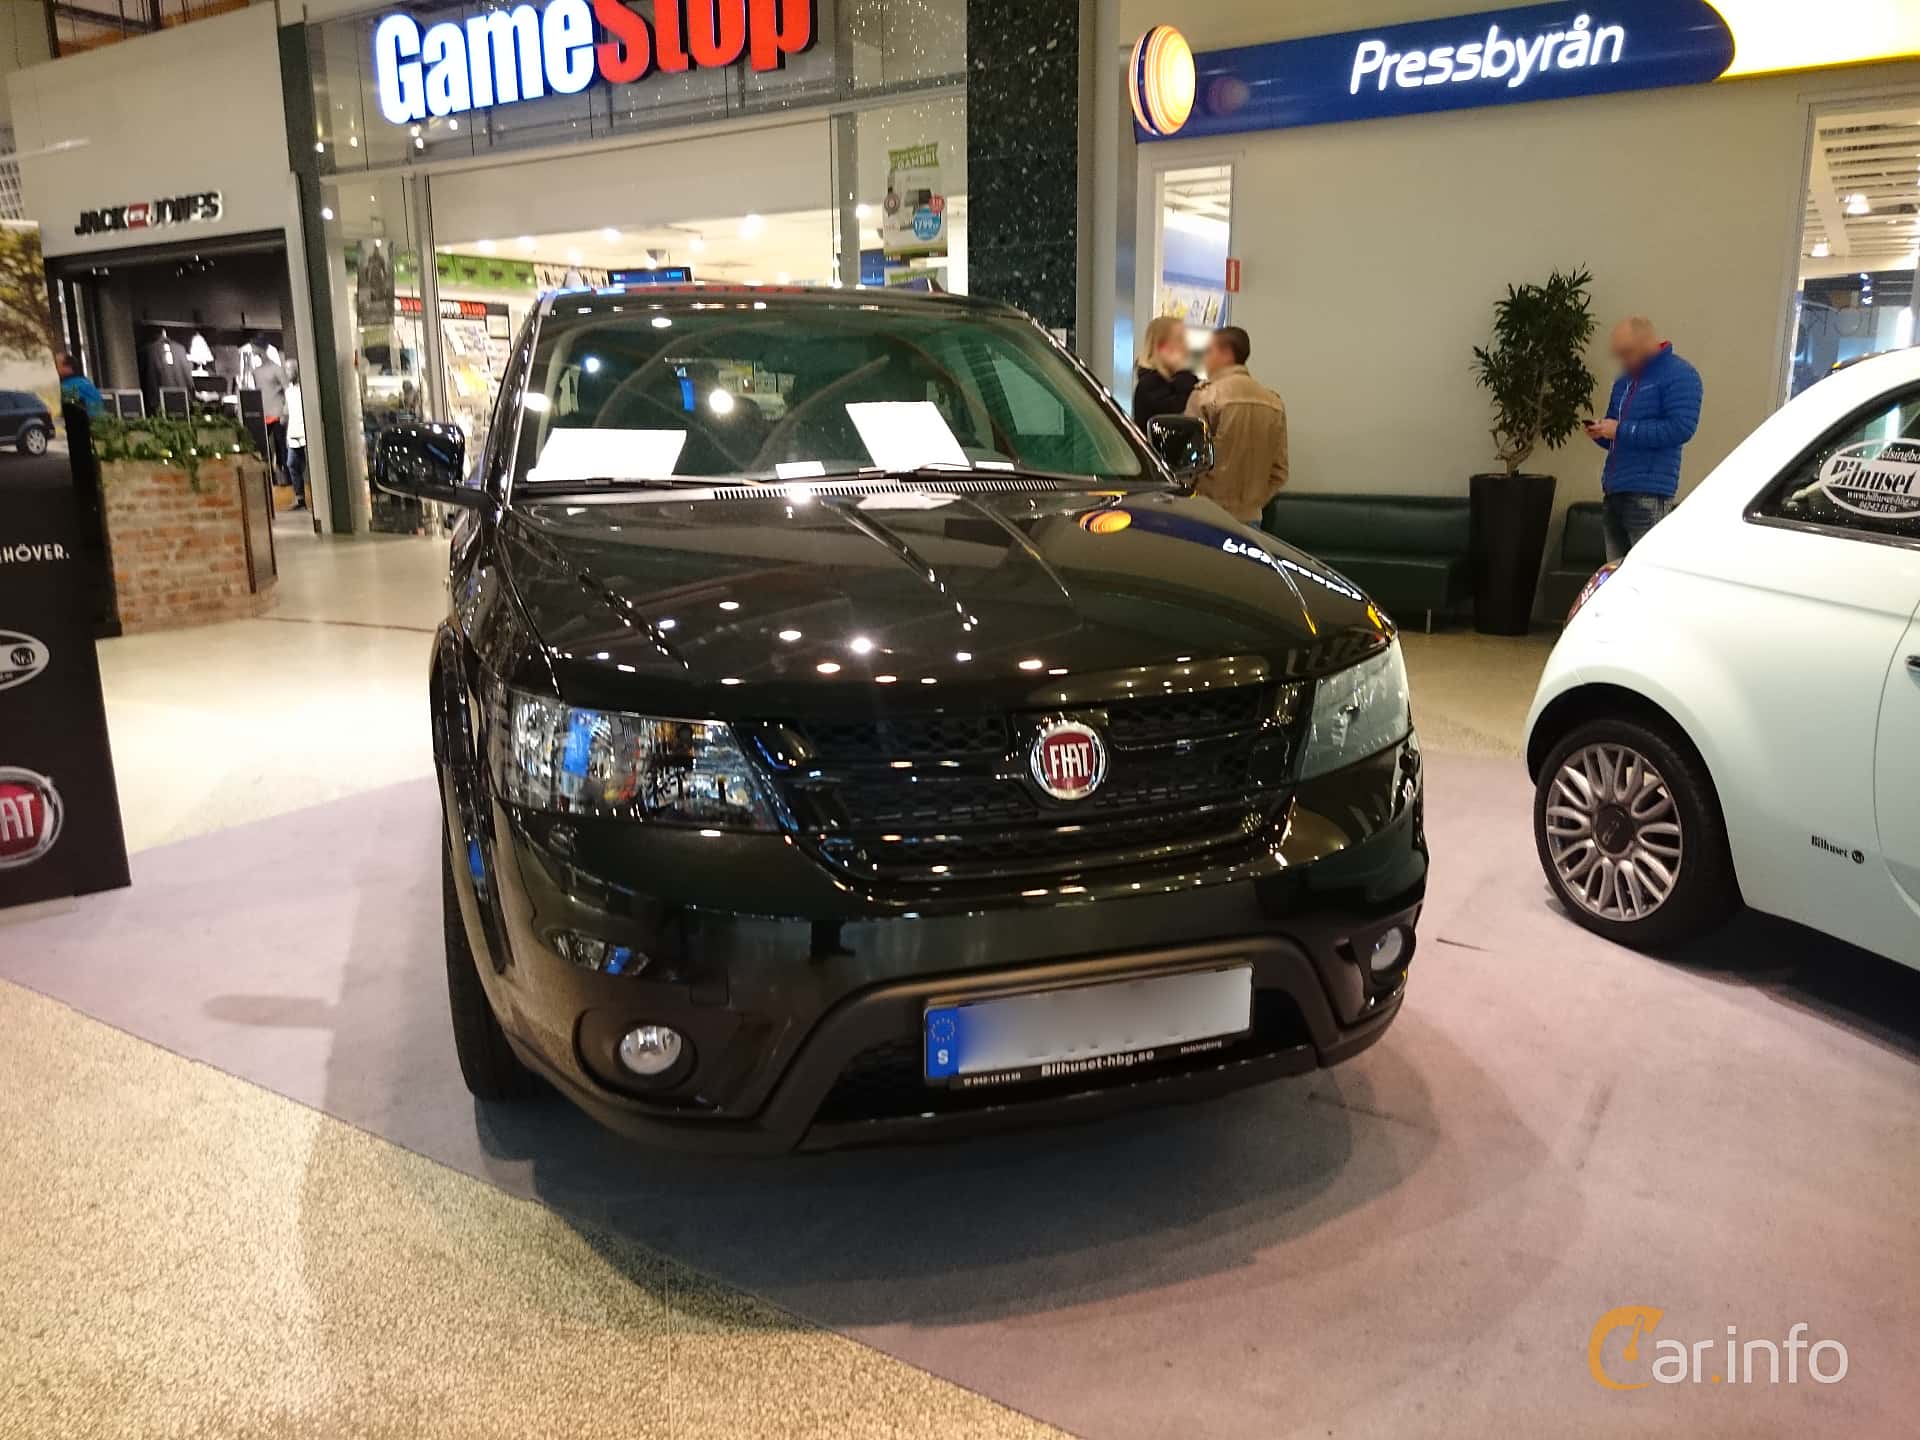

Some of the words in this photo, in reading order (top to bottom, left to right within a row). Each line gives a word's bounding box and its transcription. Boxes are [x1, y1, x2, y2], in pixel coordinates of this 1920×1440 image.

[375, 0, 813, 125] GameStop
[1349, 14, 1625, 95] Pressbyrån
[74, 205, 128, 236] JACK
[0, 543, 71, 563] HÖVER.
[1049, 742, 1091, 780] FIAT
[937, 1049, 949, 1065] S
